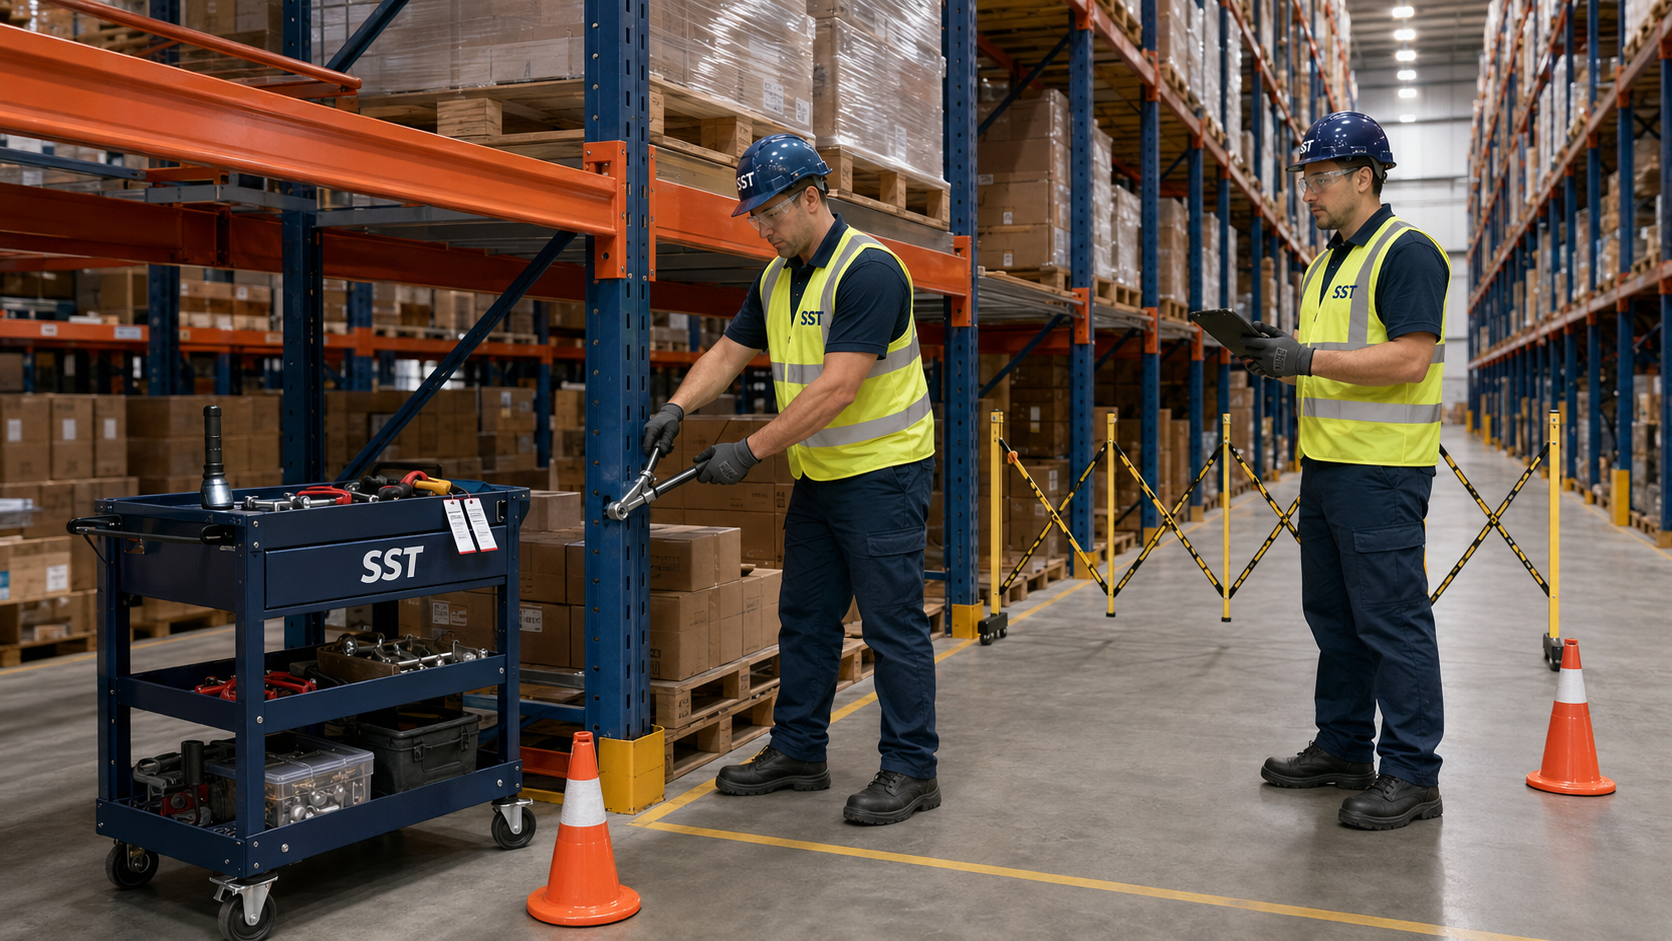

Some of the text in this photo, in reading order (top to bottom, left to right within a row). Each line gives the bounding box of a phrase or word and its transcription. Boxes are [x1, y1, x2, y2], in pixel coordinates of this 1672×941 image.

[1332, 285, 1358, 299] SST
[800, 310, 824, 326] SST
[360, 545, 425, 584] SST
